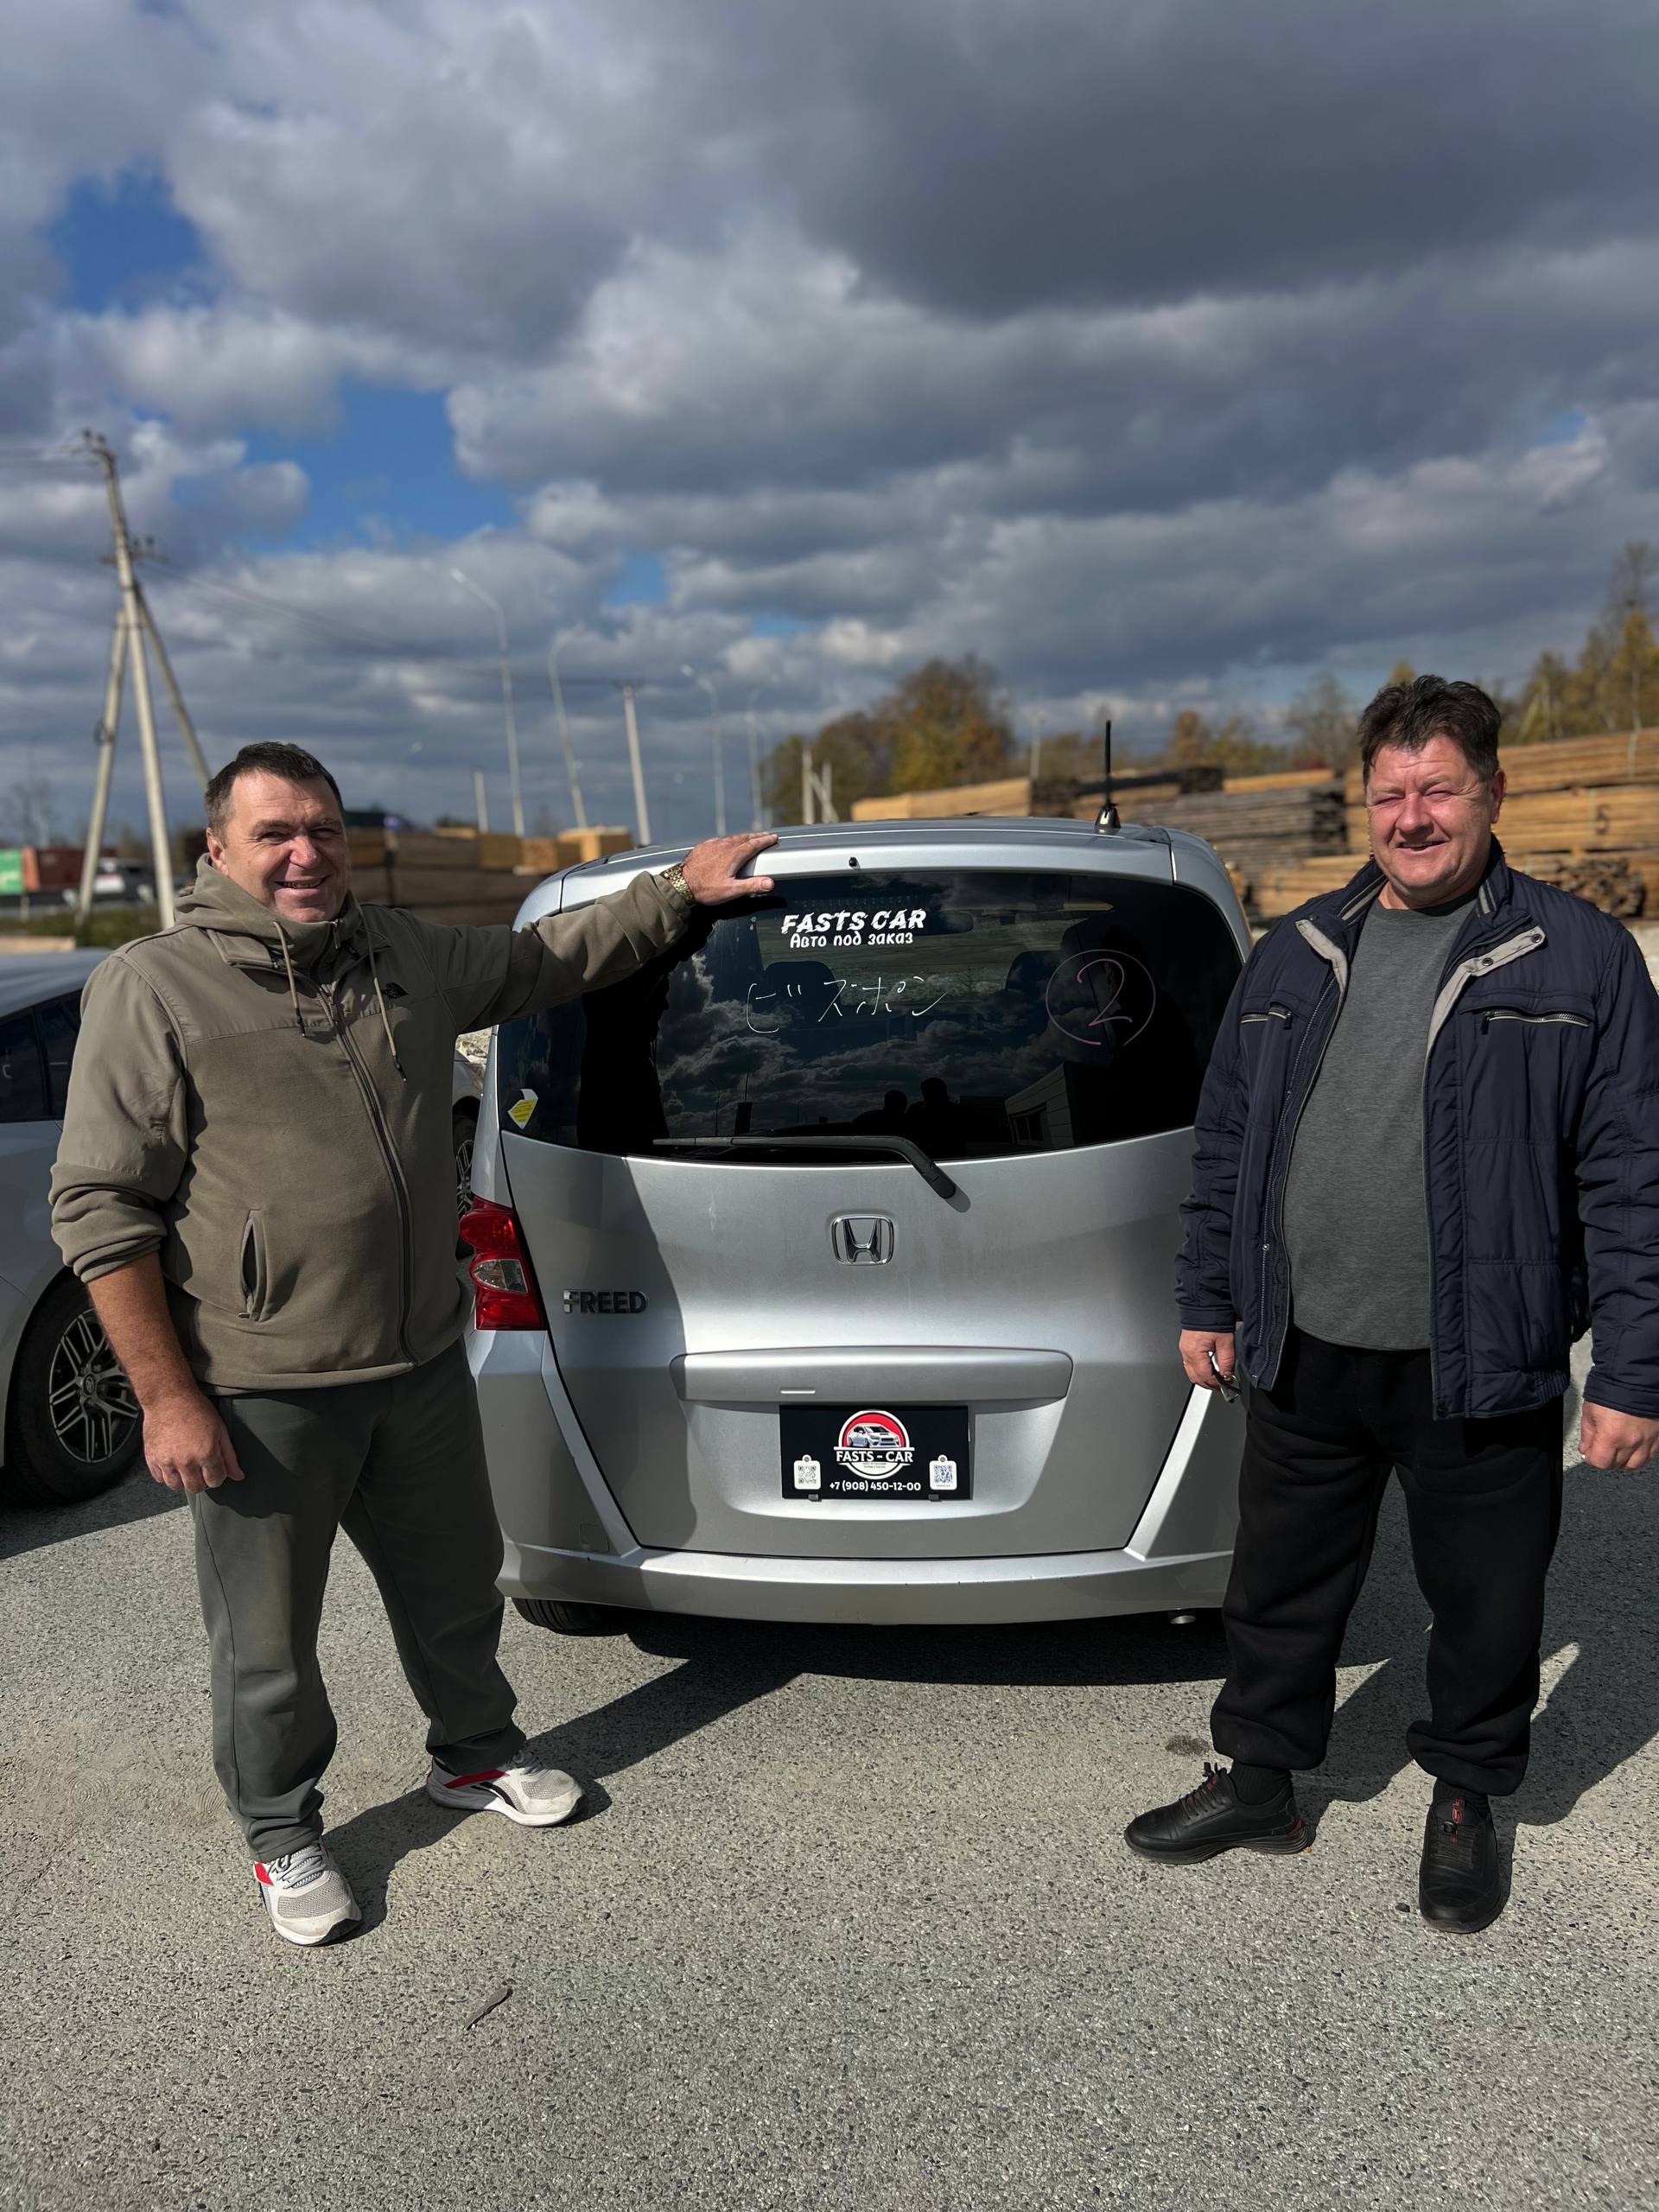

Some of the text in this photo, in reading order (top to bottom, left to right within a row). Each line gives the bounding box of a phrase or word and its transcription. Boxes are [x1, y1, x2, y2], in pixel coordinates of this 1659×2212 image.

[781, 908, 926, 934] FASTS CAR
[790, 931, 913, 949] Авто под заказ
[563, 1289, 647, 1313] FREED
[836, 1451, 874, 1462] FASTS
[886, 1451, 913, 1462] CAR
[830, 1479, 922, 1491] +7 (908) 450-12-00
